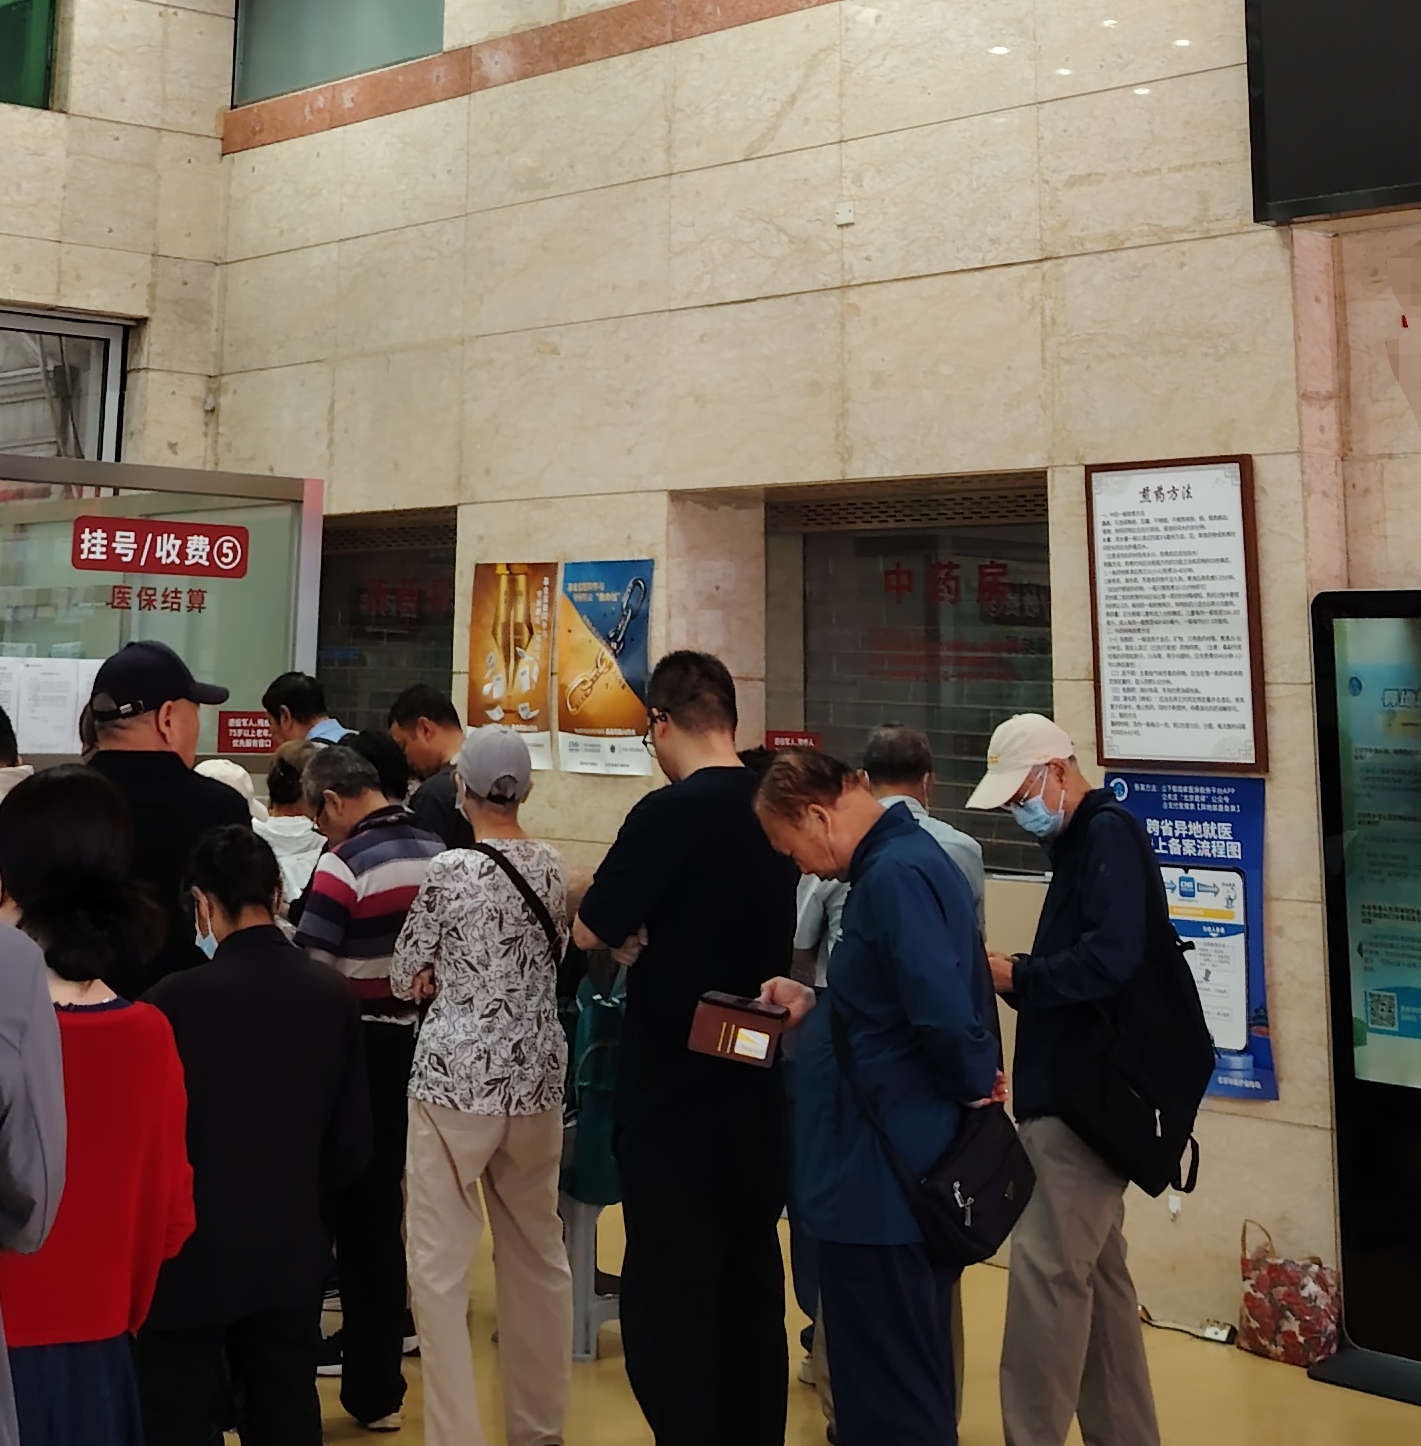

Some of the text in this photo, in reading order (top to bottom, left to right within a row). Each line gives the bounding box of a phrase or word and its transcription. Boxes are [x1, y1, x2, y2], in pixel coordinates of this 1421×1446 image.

[1139, 483, 1193, 504] 煎药方法
[80, 528, 242, 570] 挂号/收费⑤
[884, 561, 1008, 605] 中药房
[111, 585, 207, 613] 医保结算
[1146, 818, 1234, 840] 跨省异地就医
[1150, 836, 1243, 860] 上备案流程图
